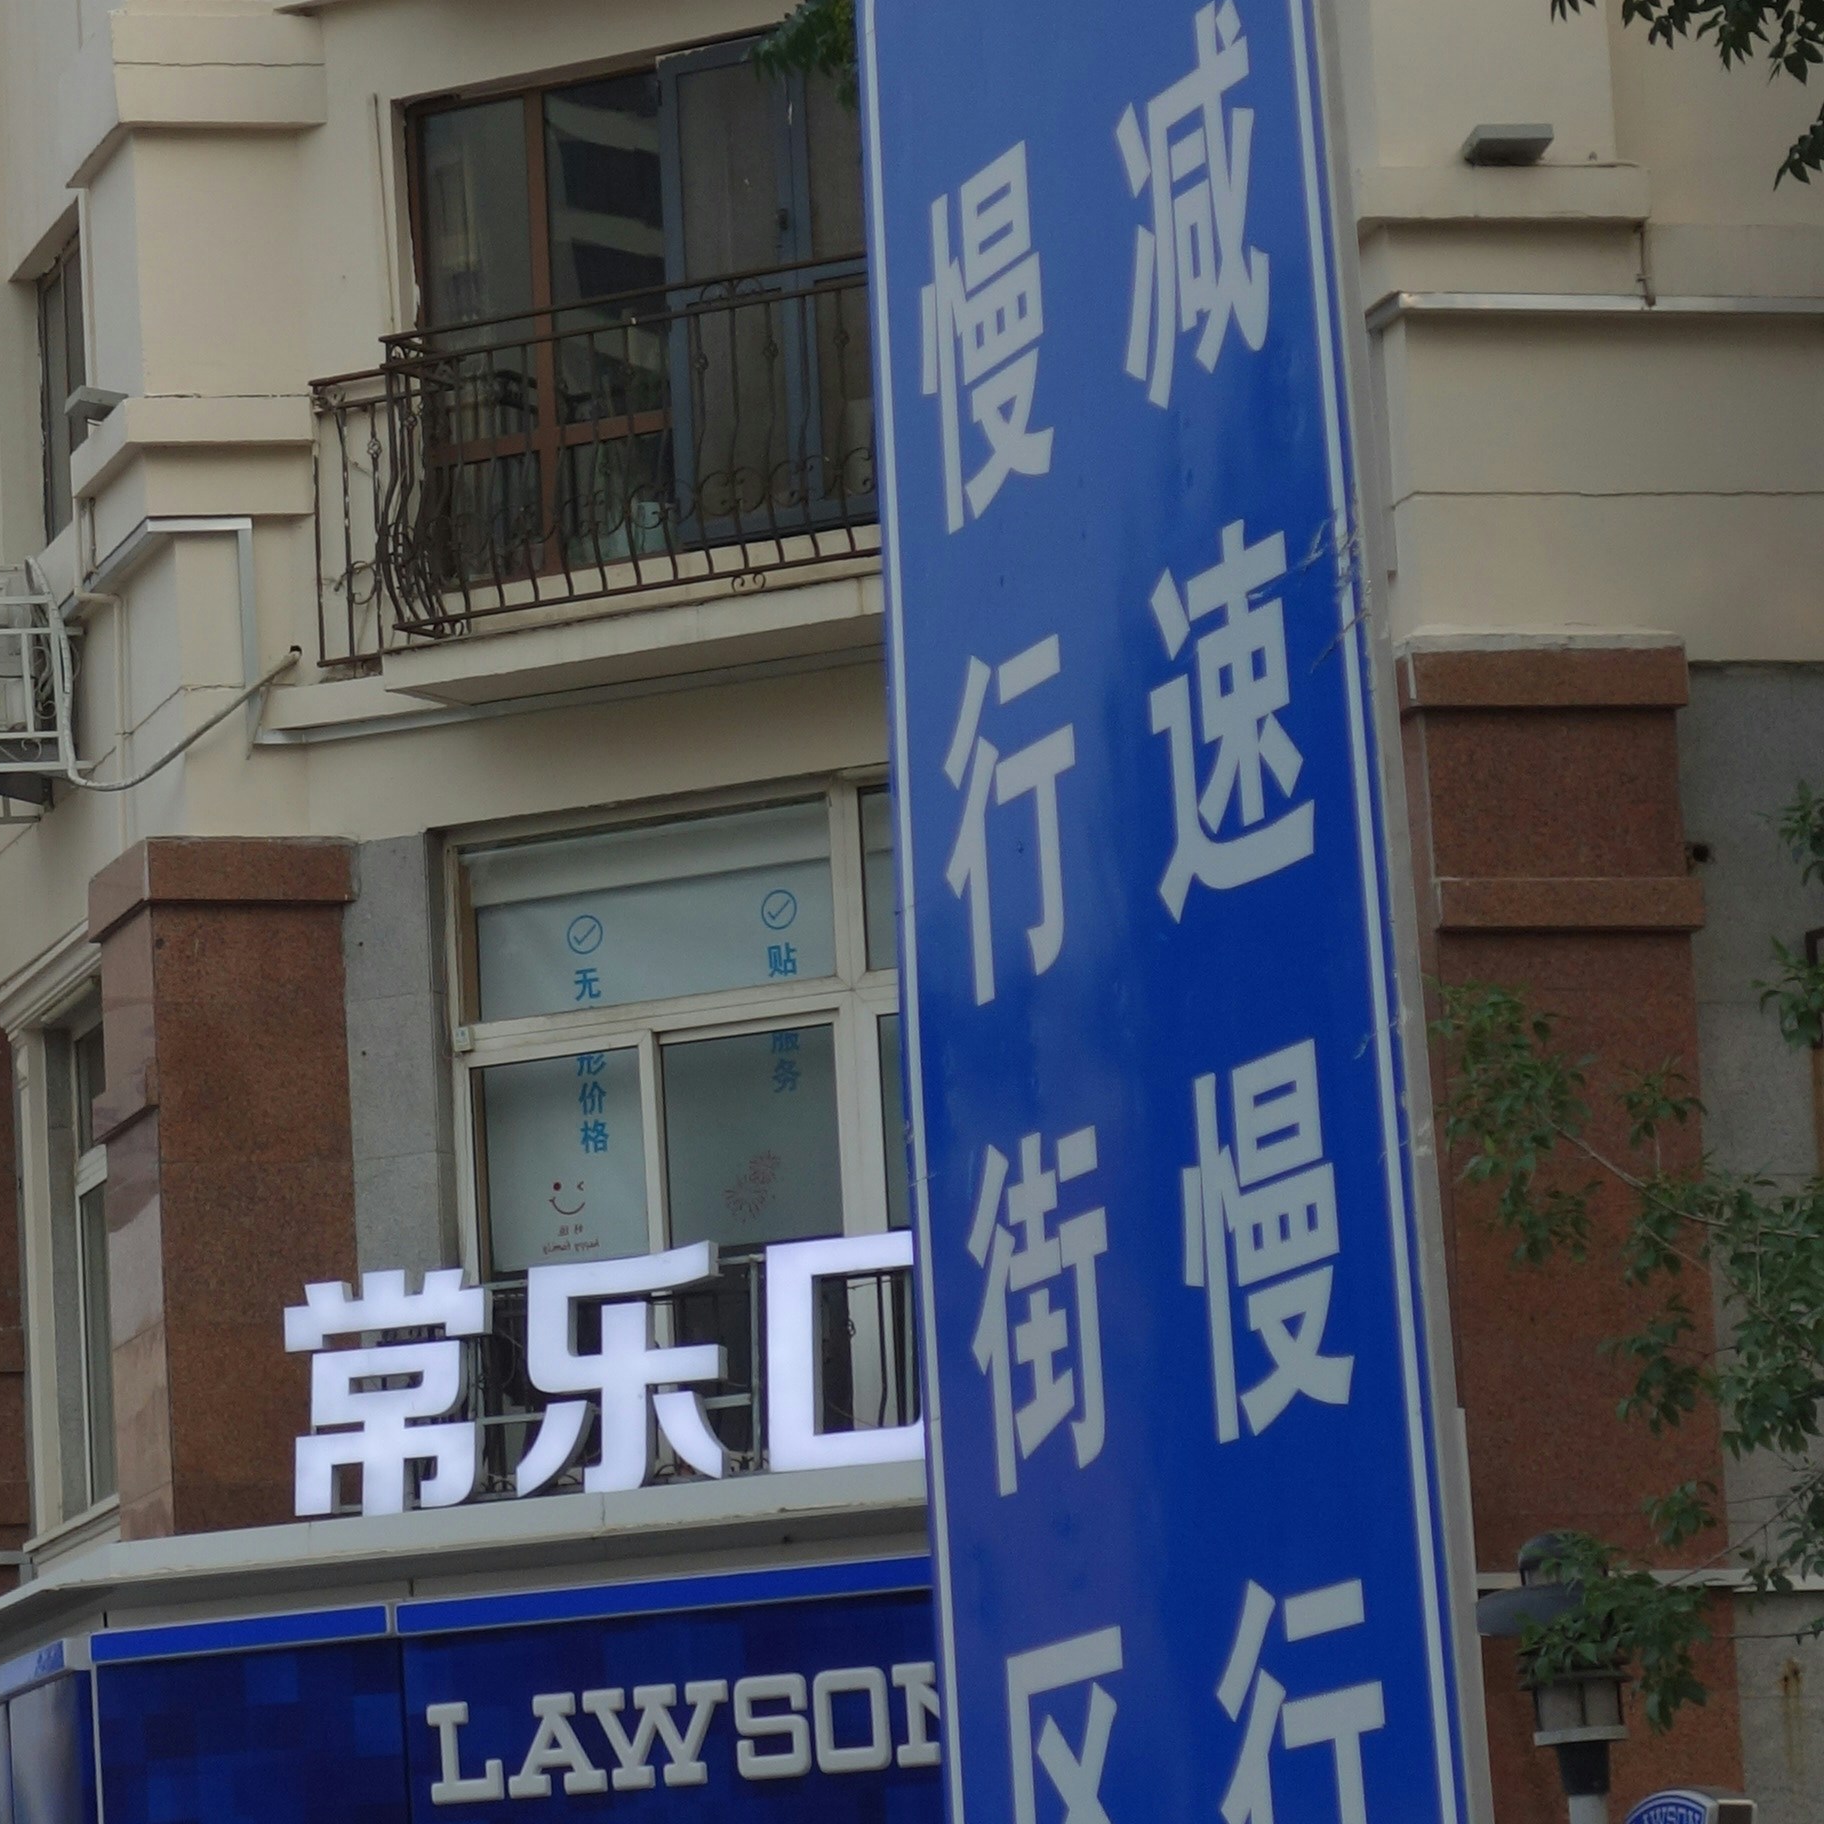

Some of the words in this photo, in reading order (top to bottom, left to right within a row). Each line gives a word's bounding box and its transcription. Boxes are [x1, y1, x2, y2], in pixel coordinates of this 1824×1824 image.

[573, 966, 610, 1155] 无形价格
[766, 942, 801, 1095] 贴服务
[425, 1661, 941, 1807] LAWSON
